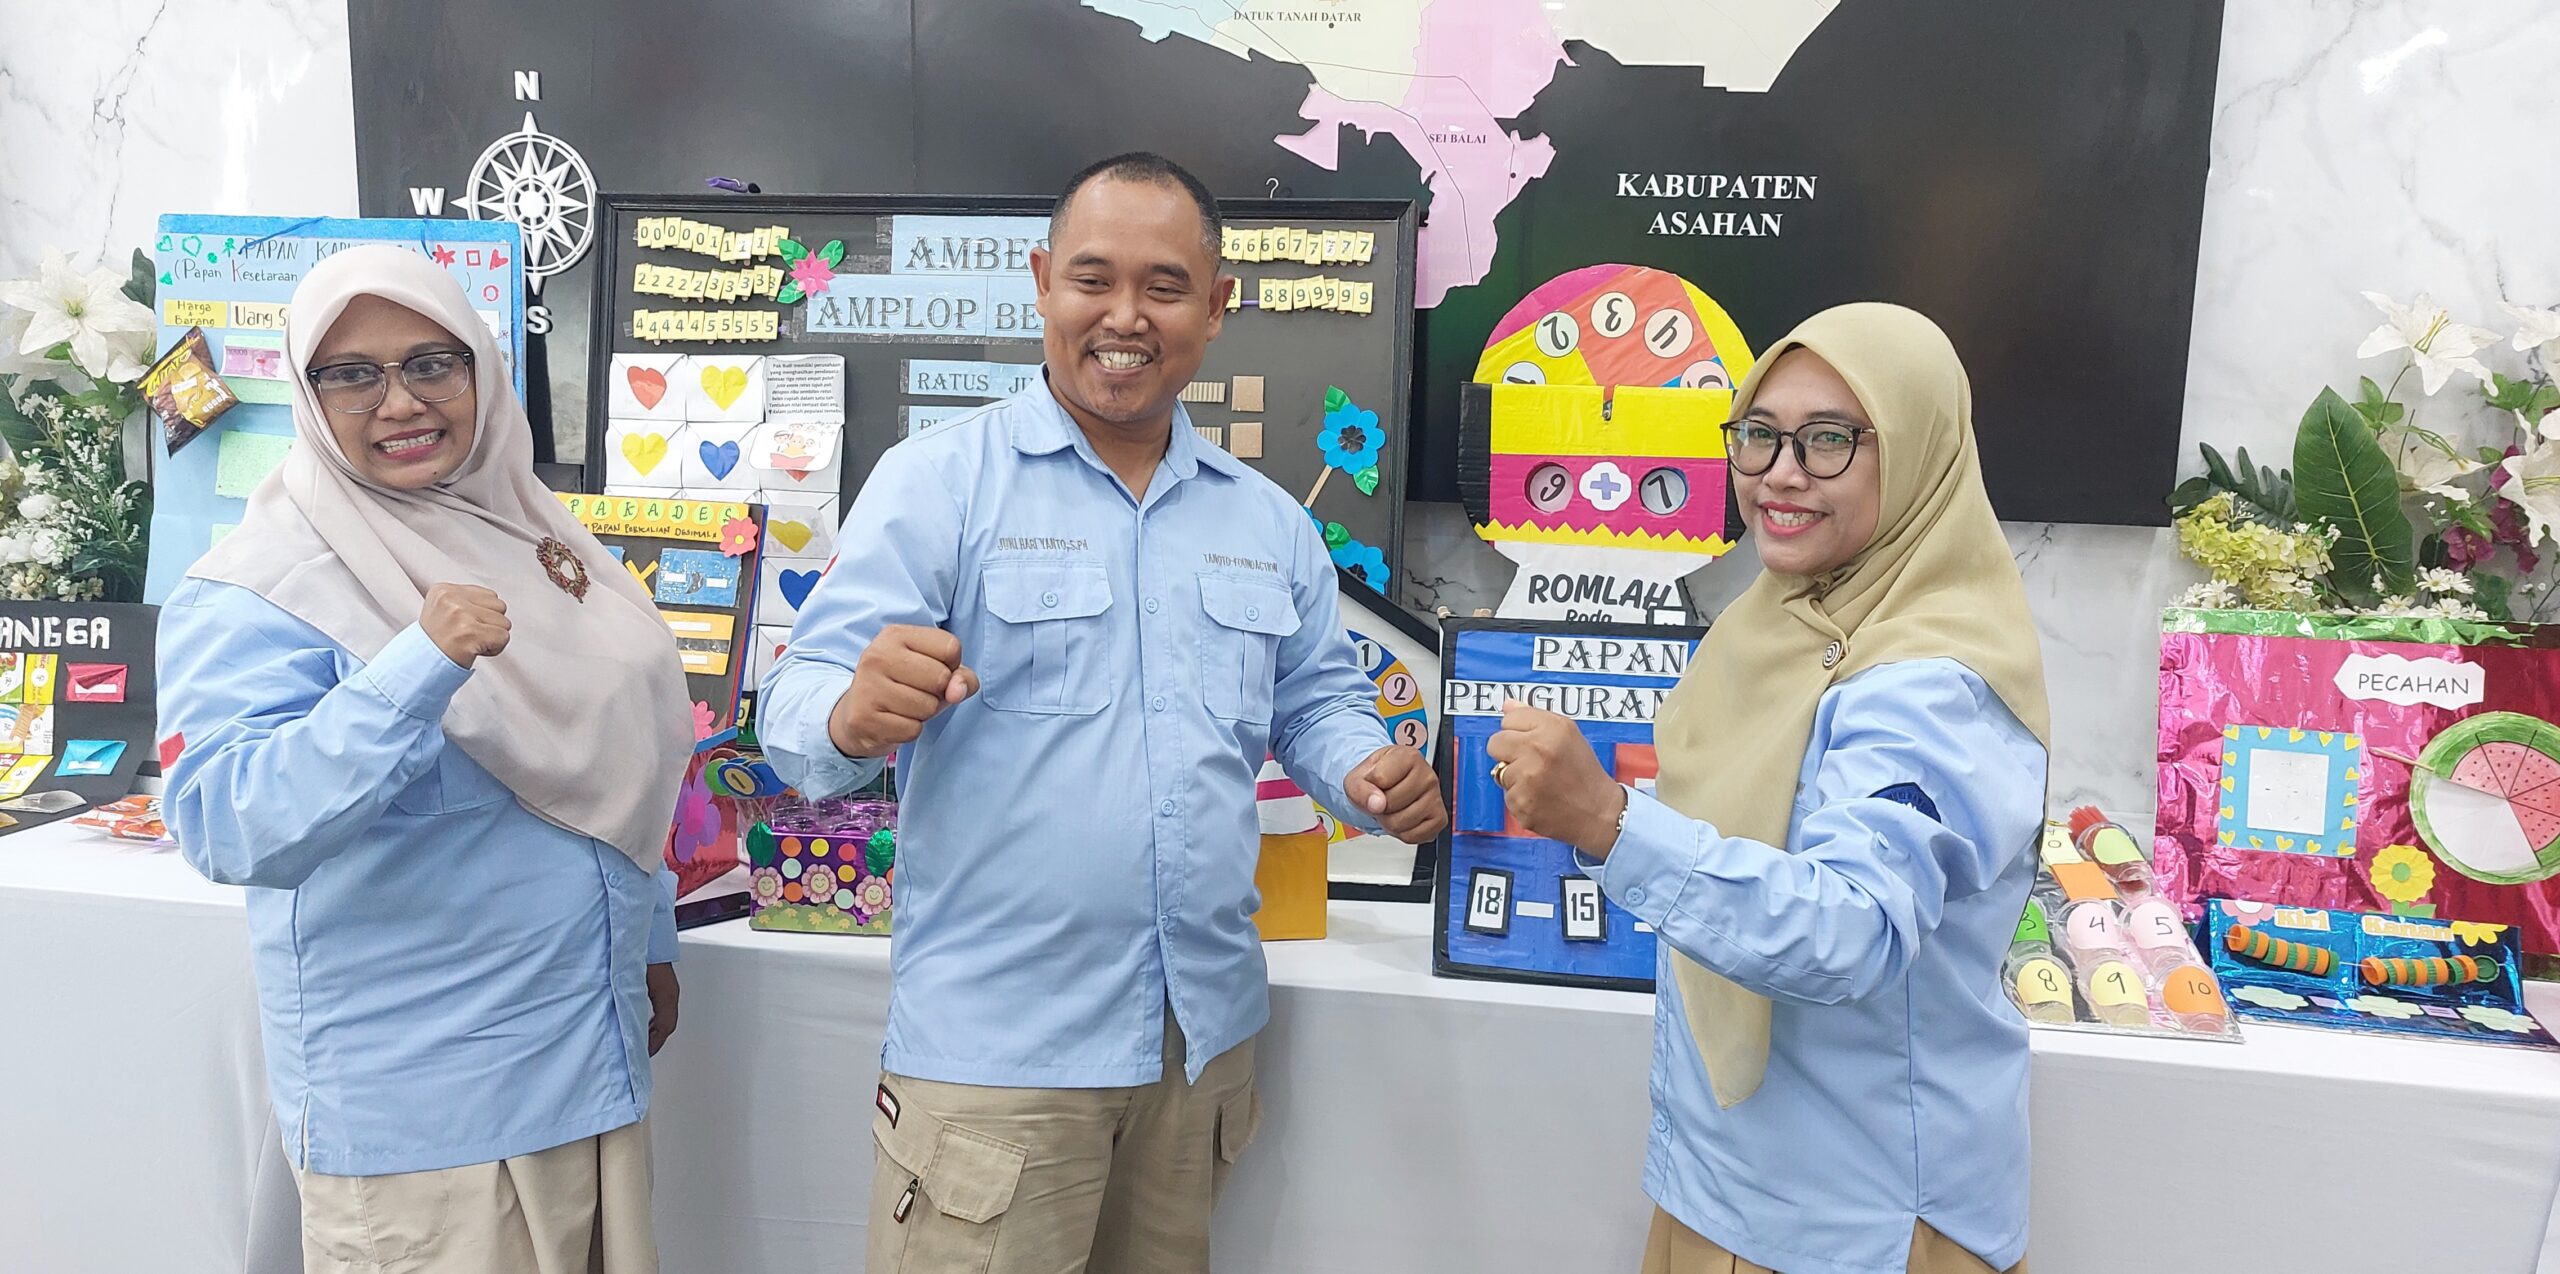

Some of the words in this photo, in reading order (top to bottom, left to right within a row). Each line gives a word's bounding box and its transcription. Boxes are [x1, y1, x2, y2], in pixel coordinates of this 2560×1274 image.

[1233, 11, 1274, 21] DATUK
[1277, 12, 1317, 21] TANAH
[1321, 12, 1361, 22] DATAR
[514, 70, 540, 101] N
[1429, 133, 1447, 144] SEI
[1450, 134, 1487, 144] BALAI
[1616, 173, 1818, 200] KABUPATEN
[409, 187, 445, 216] W
[1647, 211, 1783, 237] ASAHAN
[244, 237, 299, 260] PAPAN
[904, 236, 1048, 271] AMBE
[231, 259, 298, 282] Kesetaraan
[178, 300, 212, 315] Harga
[235, 305, 273, 328] Uang
[815, 296, 979, 330] AMPLOP
[995, 302, 1043, 331] BE
[174, 315, 215, 327] Barang
[527, 306, 552, 334] S
[918, 372, 989, 391] RATUS
[592, 522, 620, 534] PAPAN
[1528, 574, 1672, 610] ROMLAH
[1361, 643, 1370, 667] 1
[1537, 638, 1687, 676] PAPAN
[1393, 676, 1406, 700] 2
[2358, 673, 2469, 695] PECAHAN
[1446, 682, 1669, 721] PENGURAN
[1476, 885, 1500, 915] 18
[1571, 892, 1595, 921] 15
[2089, 916, 2106, 932] 4
[2156, 917, 2173, 935] 5
[2363, 916, 2453, 940] Kanan
[2037, 968, 2058, 992] 8
[2107, 972, 2126, 995] 9
[2188, 980, 2212, 996] 10
